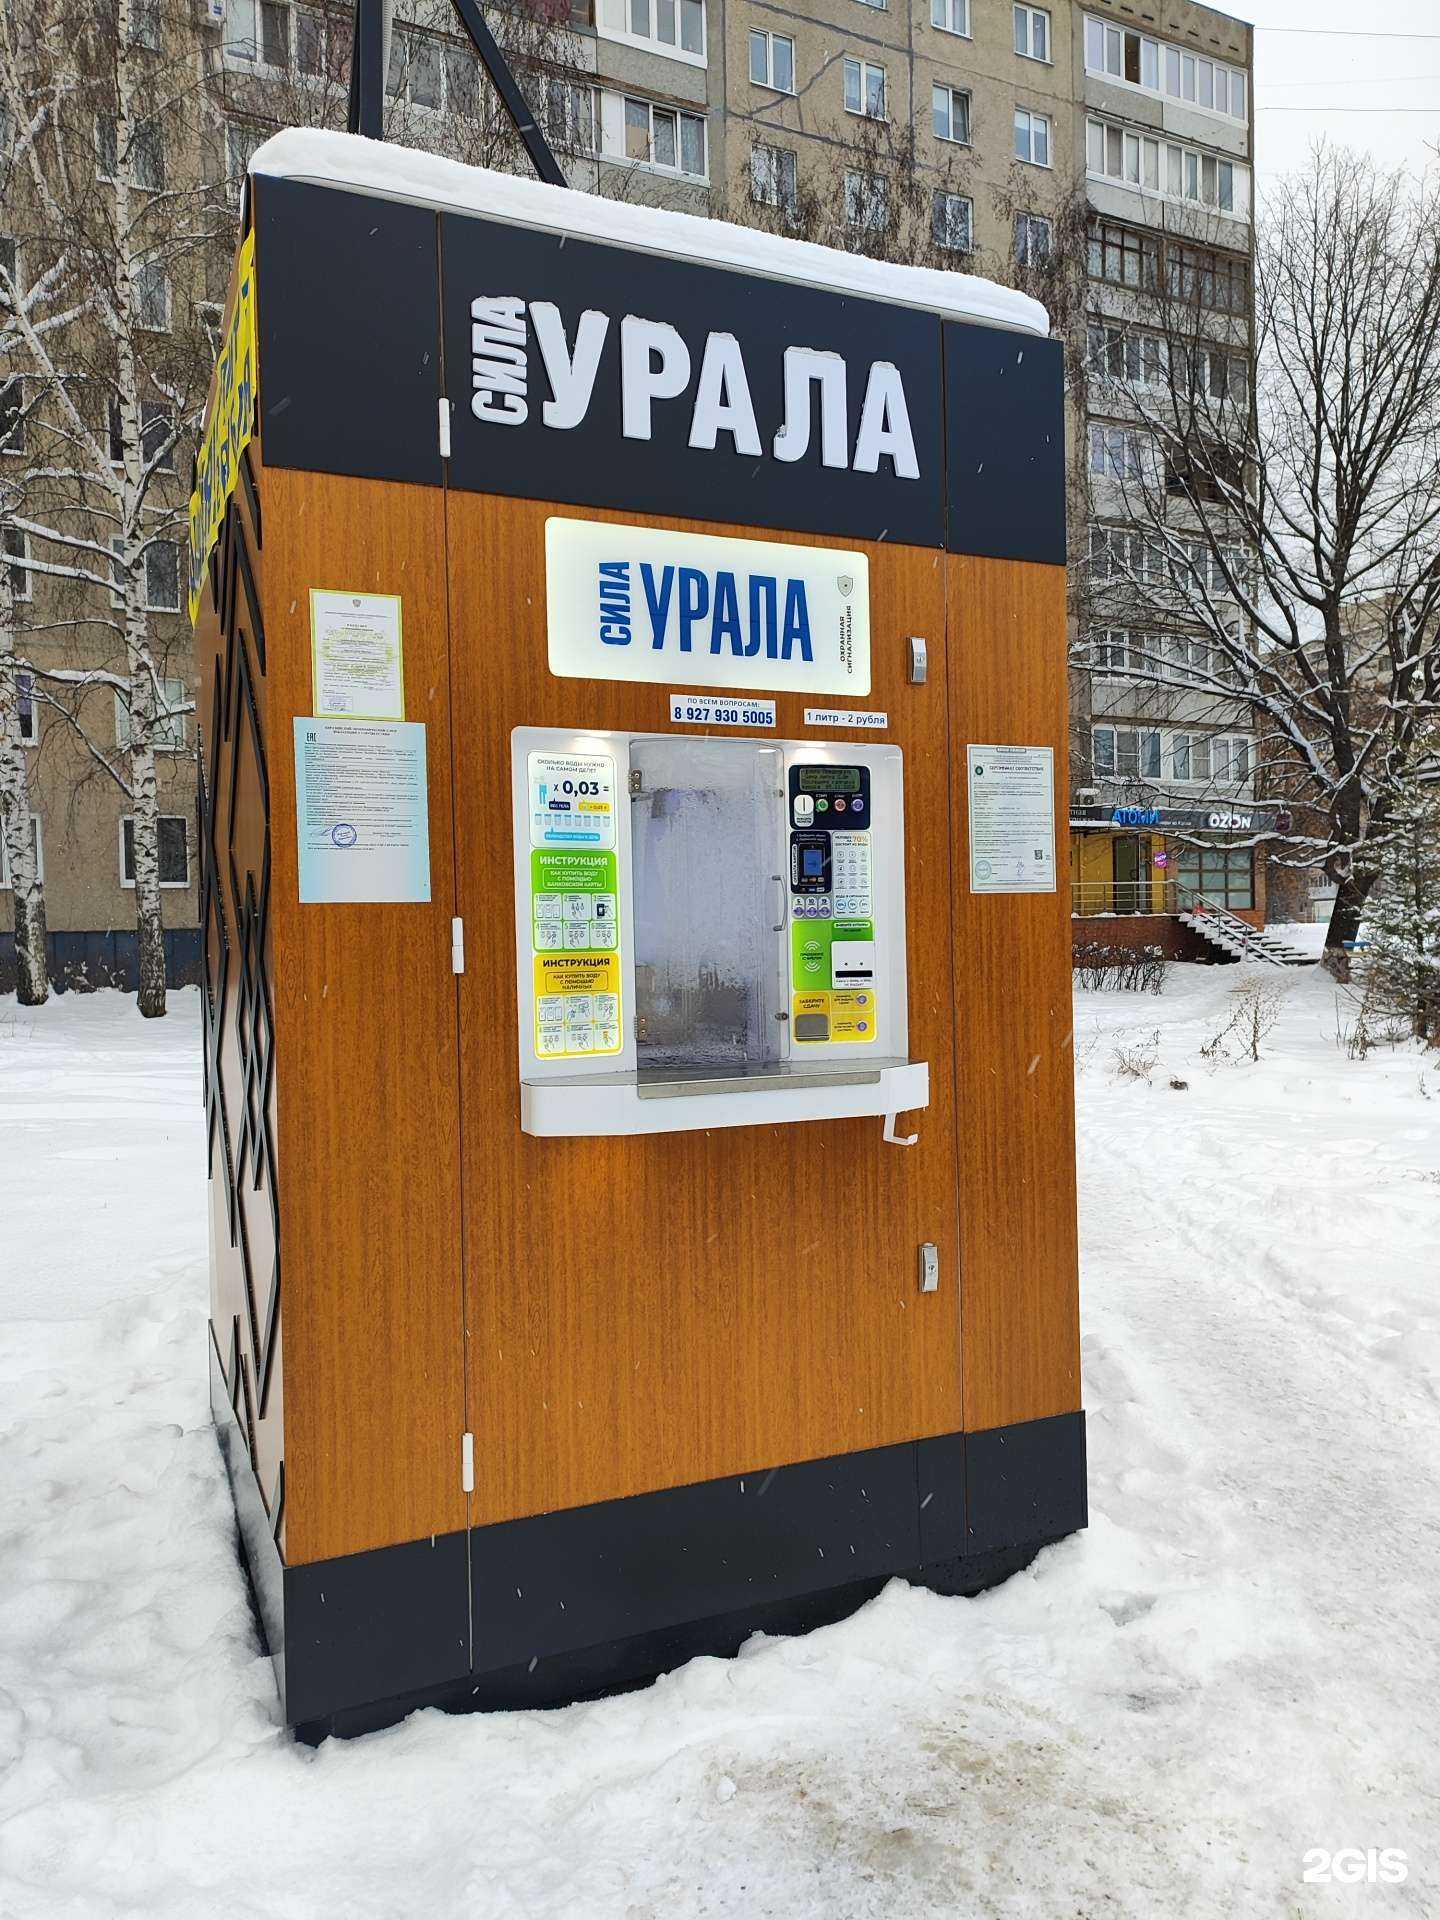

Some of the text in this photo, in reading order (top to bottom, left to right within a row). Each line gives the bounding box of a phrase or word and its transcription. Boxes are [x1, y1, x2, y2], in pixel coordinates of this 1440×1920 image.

[471, 296, 920, 480] СИЛА УРАЛА
[599, 561, 814, 662] СИЛА УРАЛА
[674, 707, 773, 724] 8 927 930 5005
[808, 712, 812, 720] 1
[815, 714, 838, 723] литр
[848, 714, 853, 722] 2
[856, 715, 885, 726] рубля
[563, 780, 599, 797] 0,03
[1208, 813, 1251, 828] OZON
[540, 856, 608, 866] ИНСТРУКЦИЯ
[543, 958, 610, 967] ИНСТРУКЦИЯ
